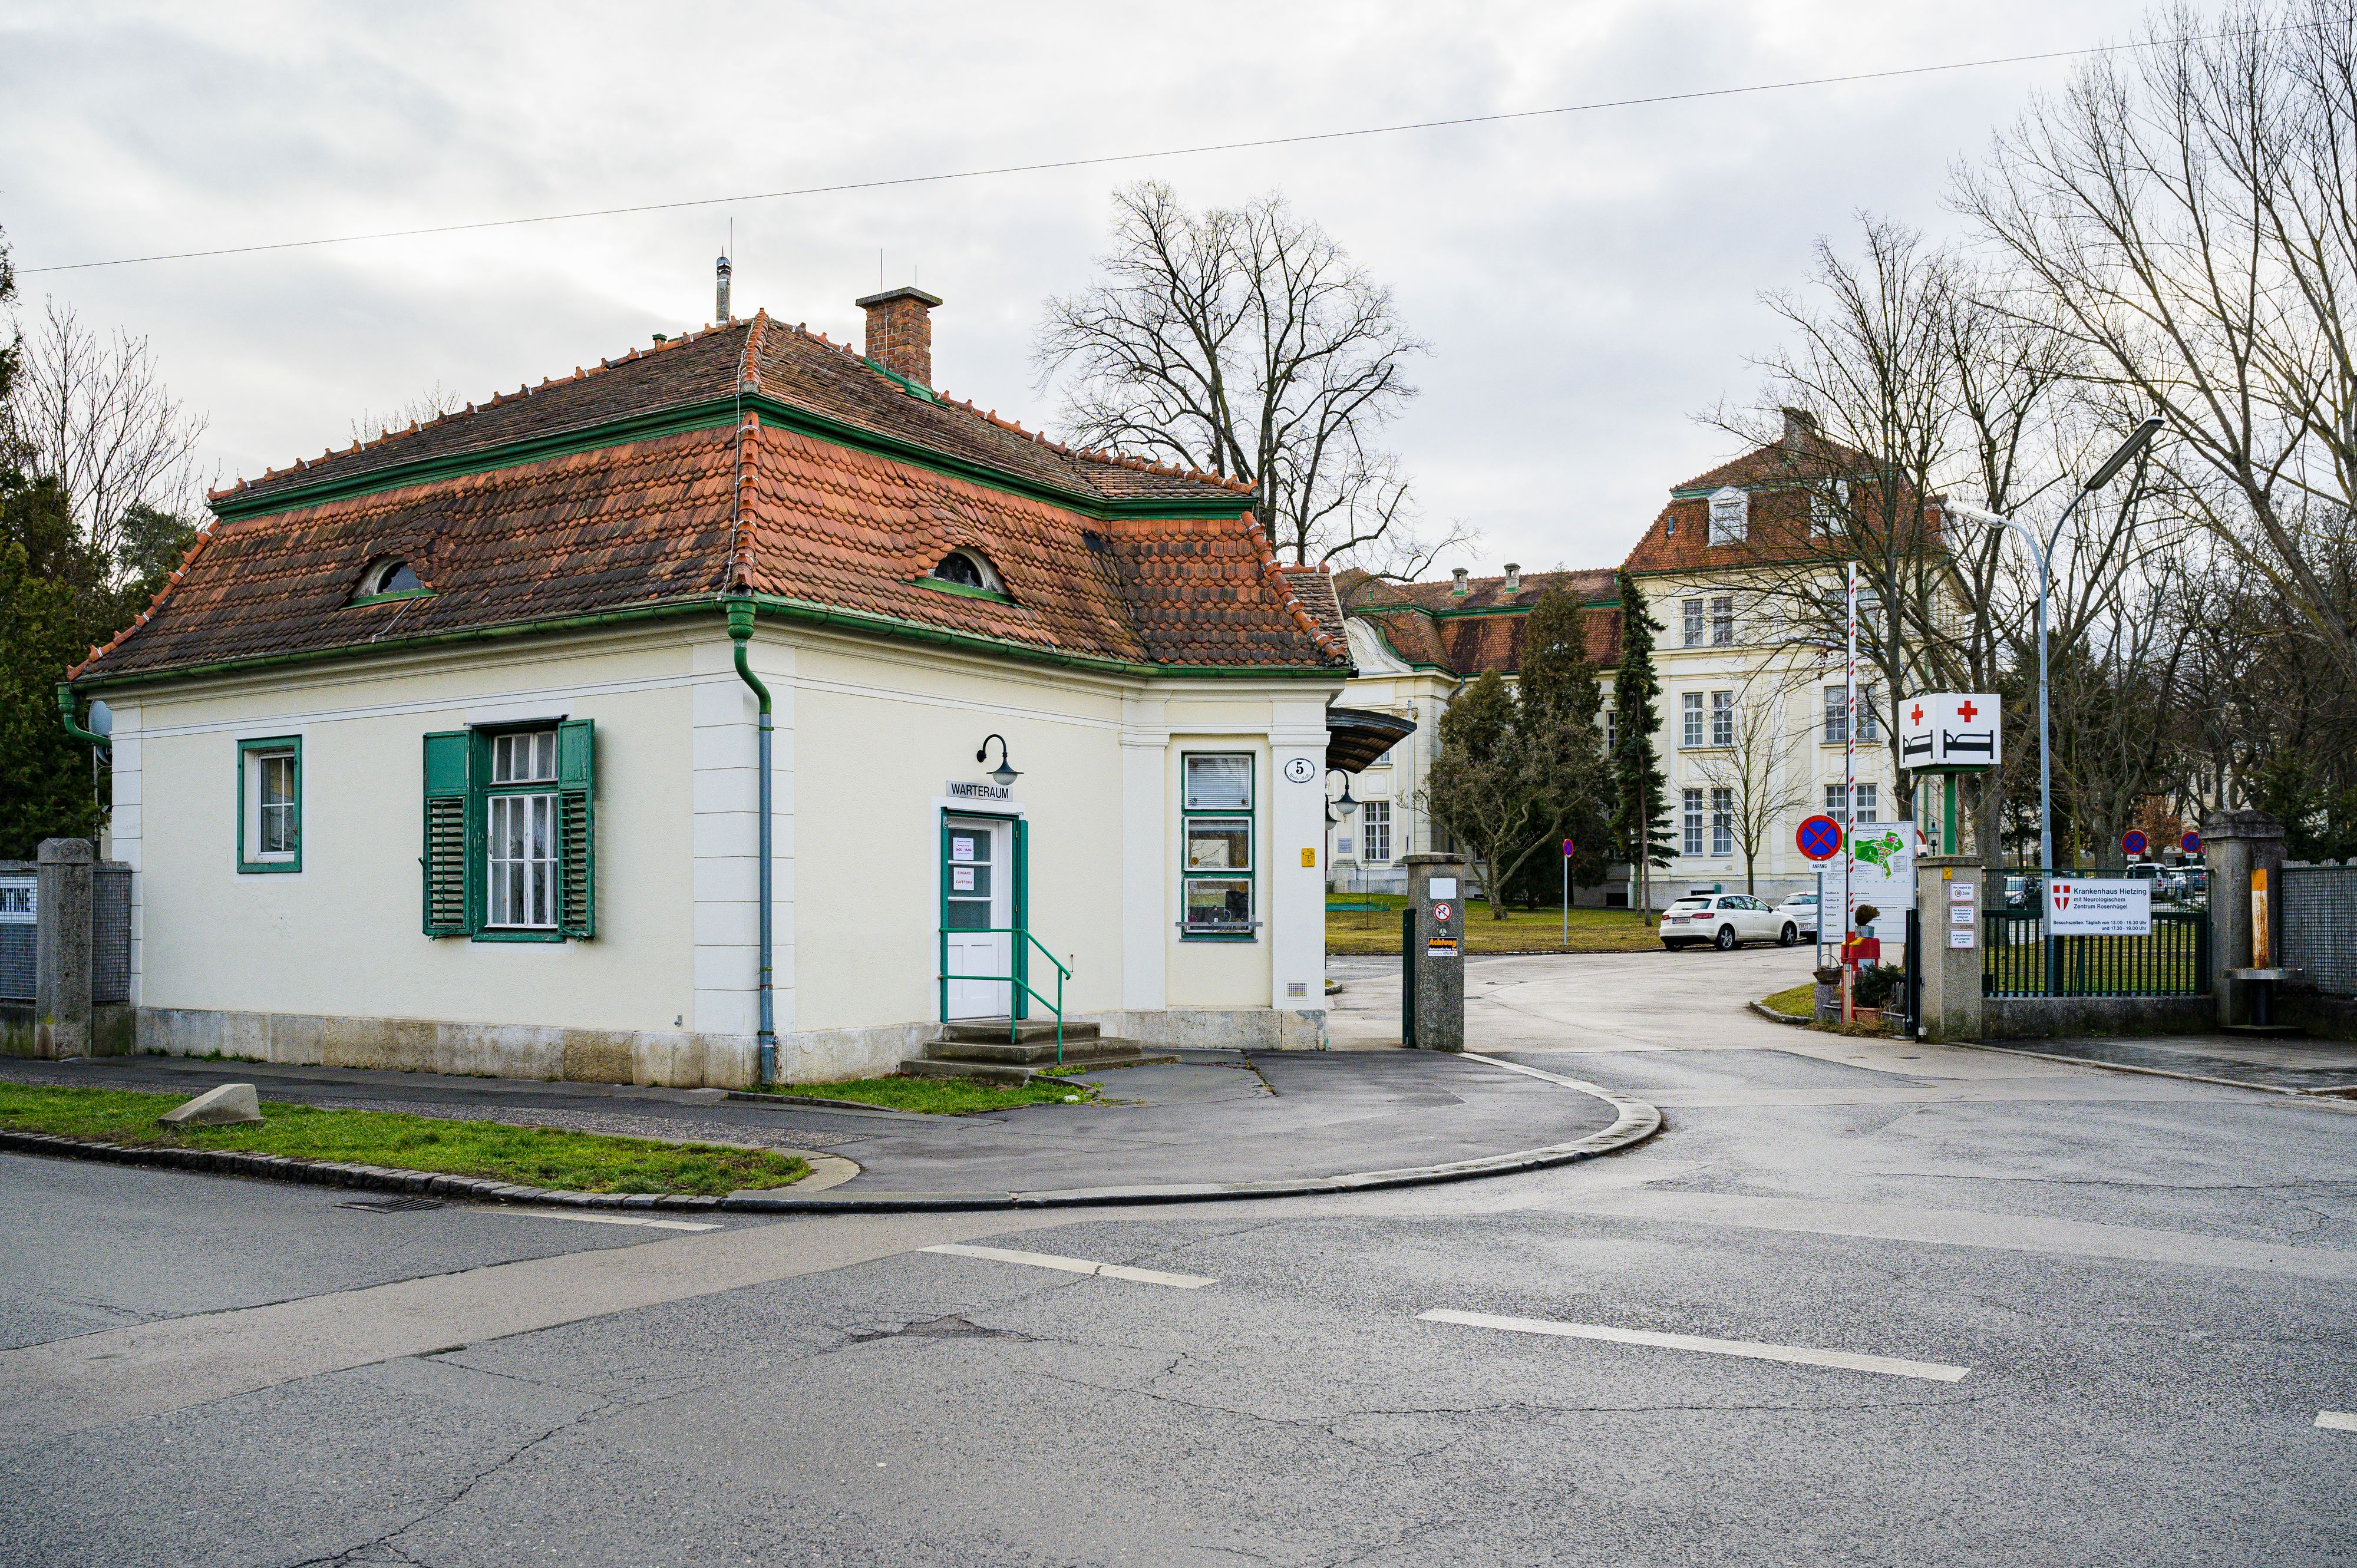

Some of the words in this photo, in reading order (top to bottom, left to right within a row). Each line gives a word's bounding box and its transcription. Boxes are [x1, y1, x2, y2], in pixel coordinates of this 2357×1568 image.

[1296, 761, 1304, 774] 5
[951, 783, 1009, 799] WARTERAUM
[2120, 888, 2147, 896] Hietzing
[1429, 938, 1457, 948] Achtung
